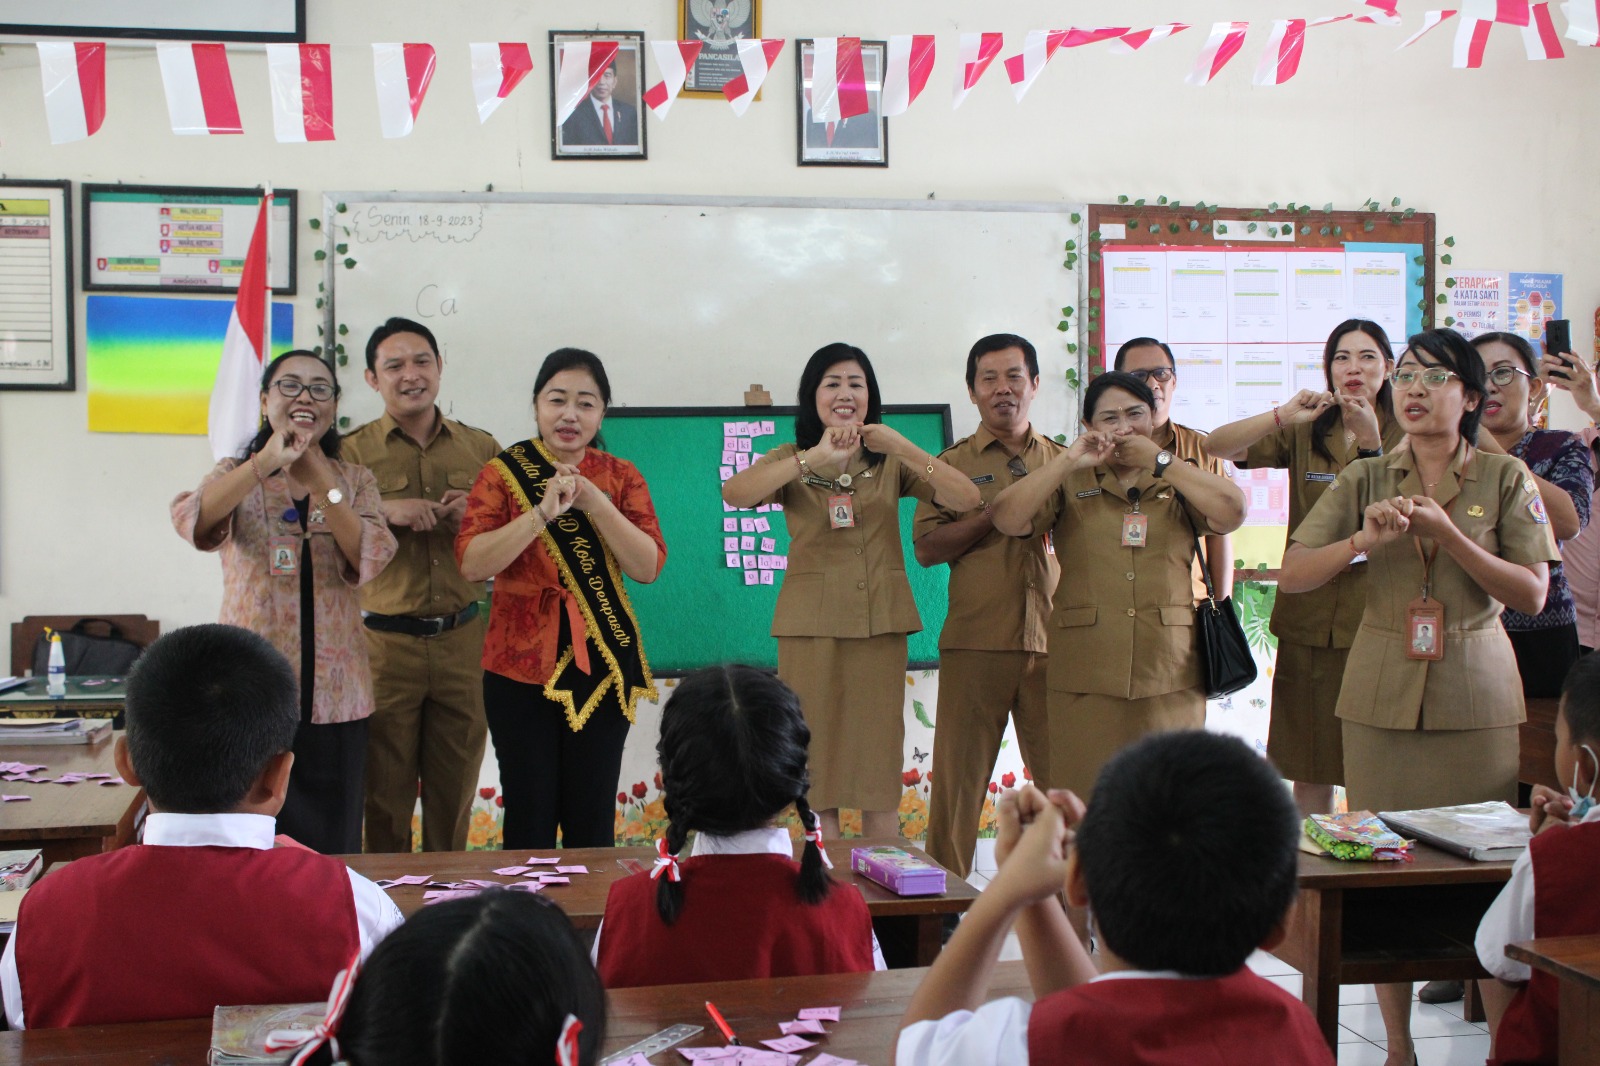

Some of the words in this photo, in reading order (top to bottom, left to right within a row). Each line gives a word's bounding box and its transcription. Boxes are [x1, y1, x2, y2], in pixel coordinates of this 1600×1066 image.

[368, 206, 410, 227] Senin
[1454, 276, 1499, 289] TERAPKAN
[416, 284, 458, 318] Ca
[1454, 290, 1459, 299] 4
[1460, 290, 1478, 300] KATA
[1480, 290, 1499, 300] SAKTI
[505, 445, 541, 479] Bunda
[569, 536, 597, 574] Kota
[588, 575, 631, 647] Denpasar
